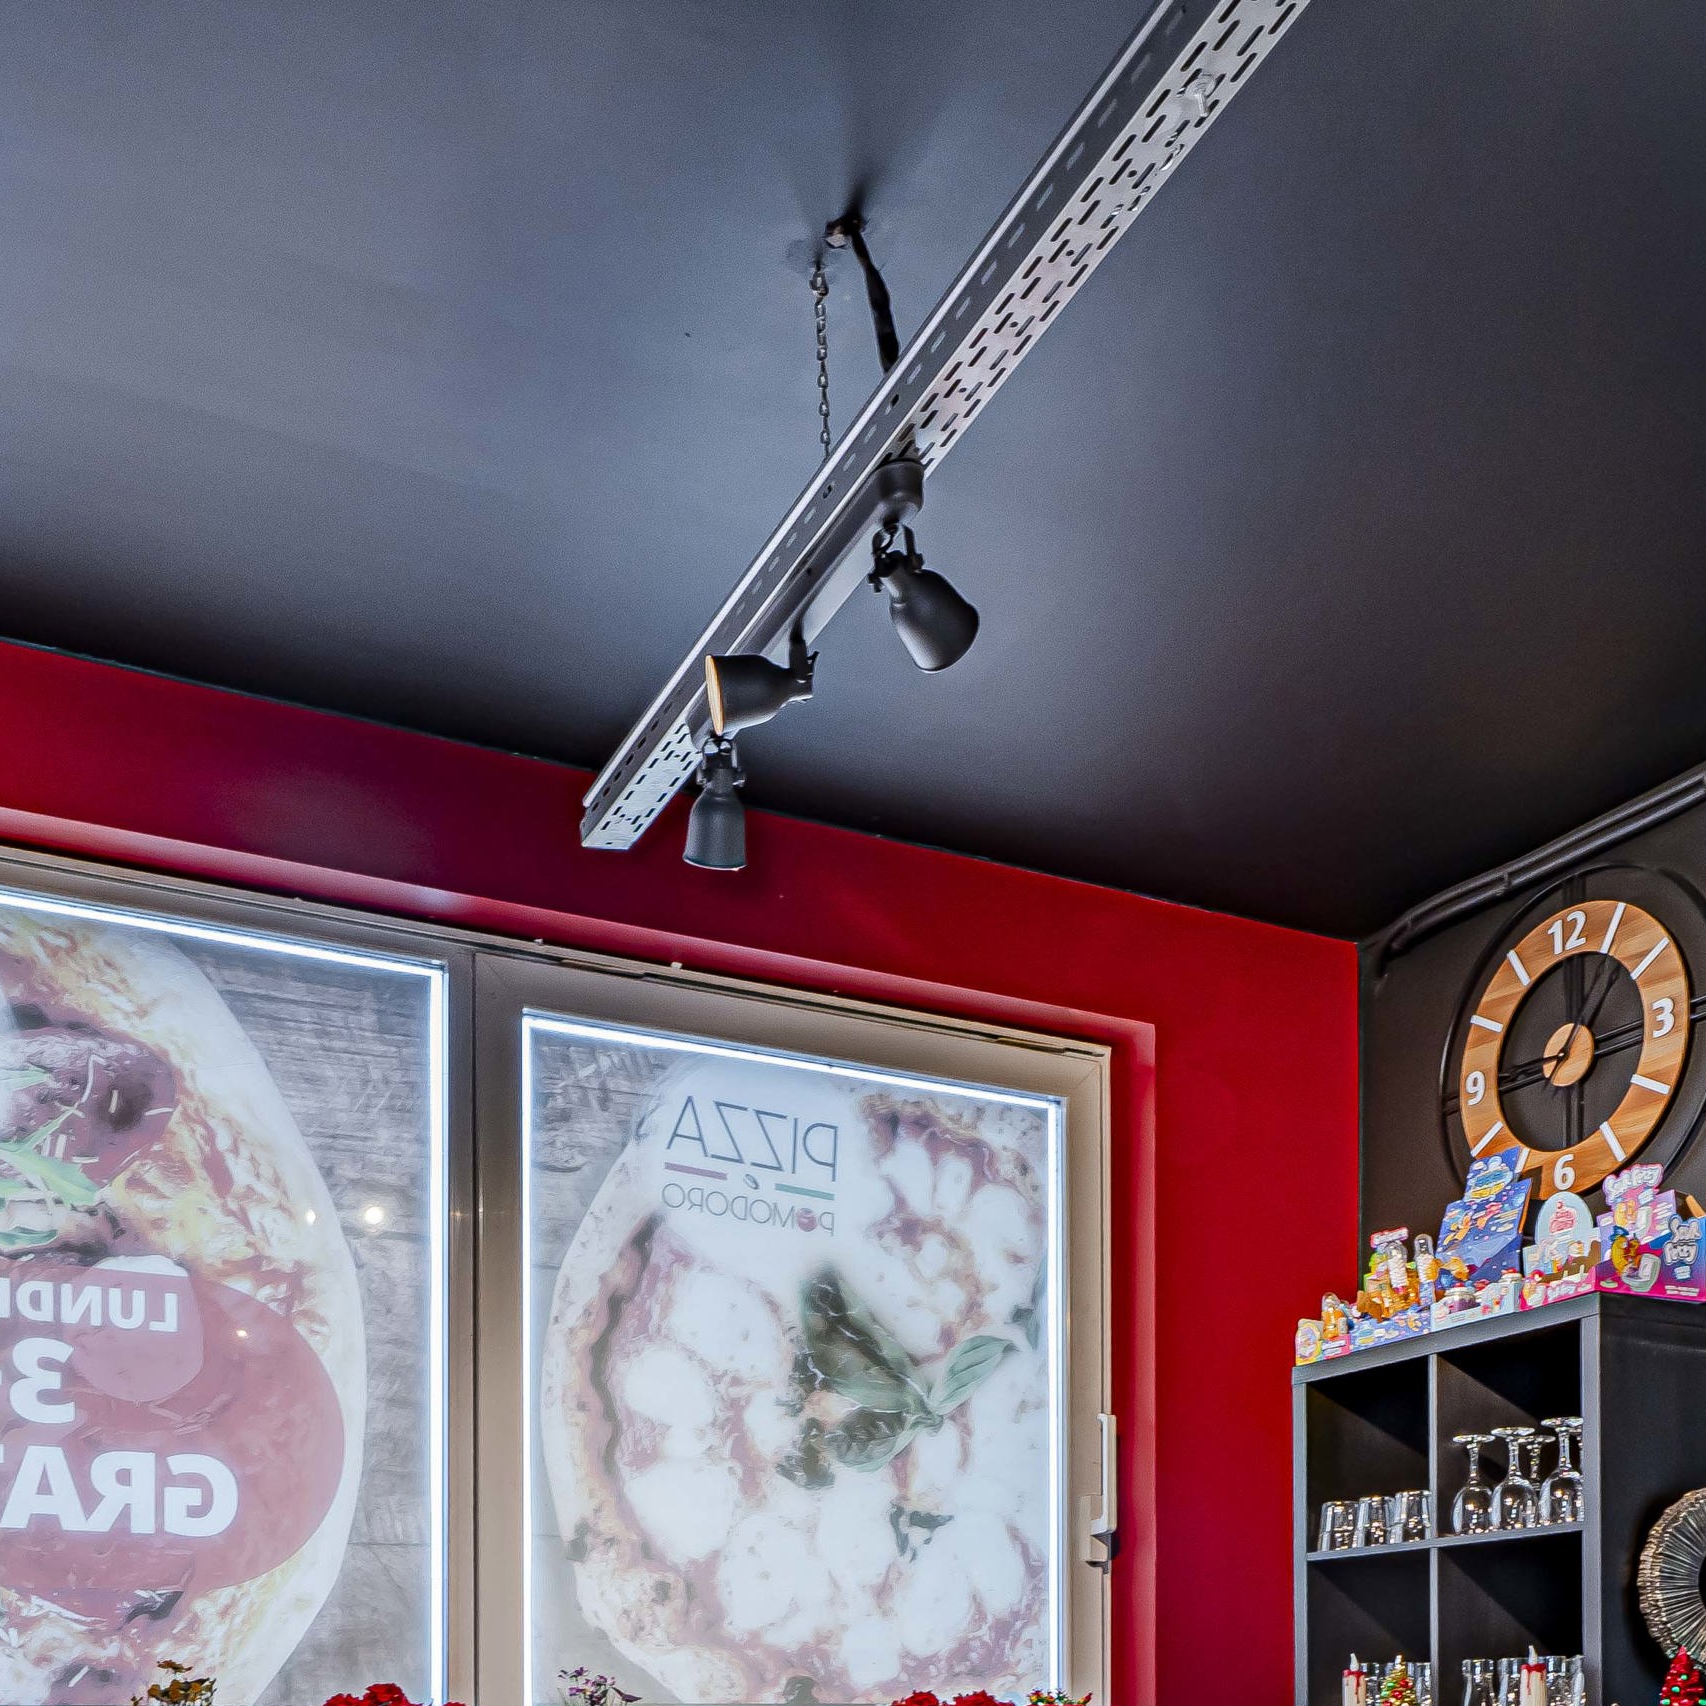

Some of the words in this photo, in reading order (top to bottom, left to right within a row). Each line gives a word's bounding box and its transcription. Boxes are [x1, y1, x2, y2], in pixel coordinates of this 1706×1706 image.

[1546, 909, 1587, 956] 12
[1652, 998, 1675, 1039] 3
[1465, 1070, 1486, 1106] 9
[1554, 1153, 1576, 1191] 6
